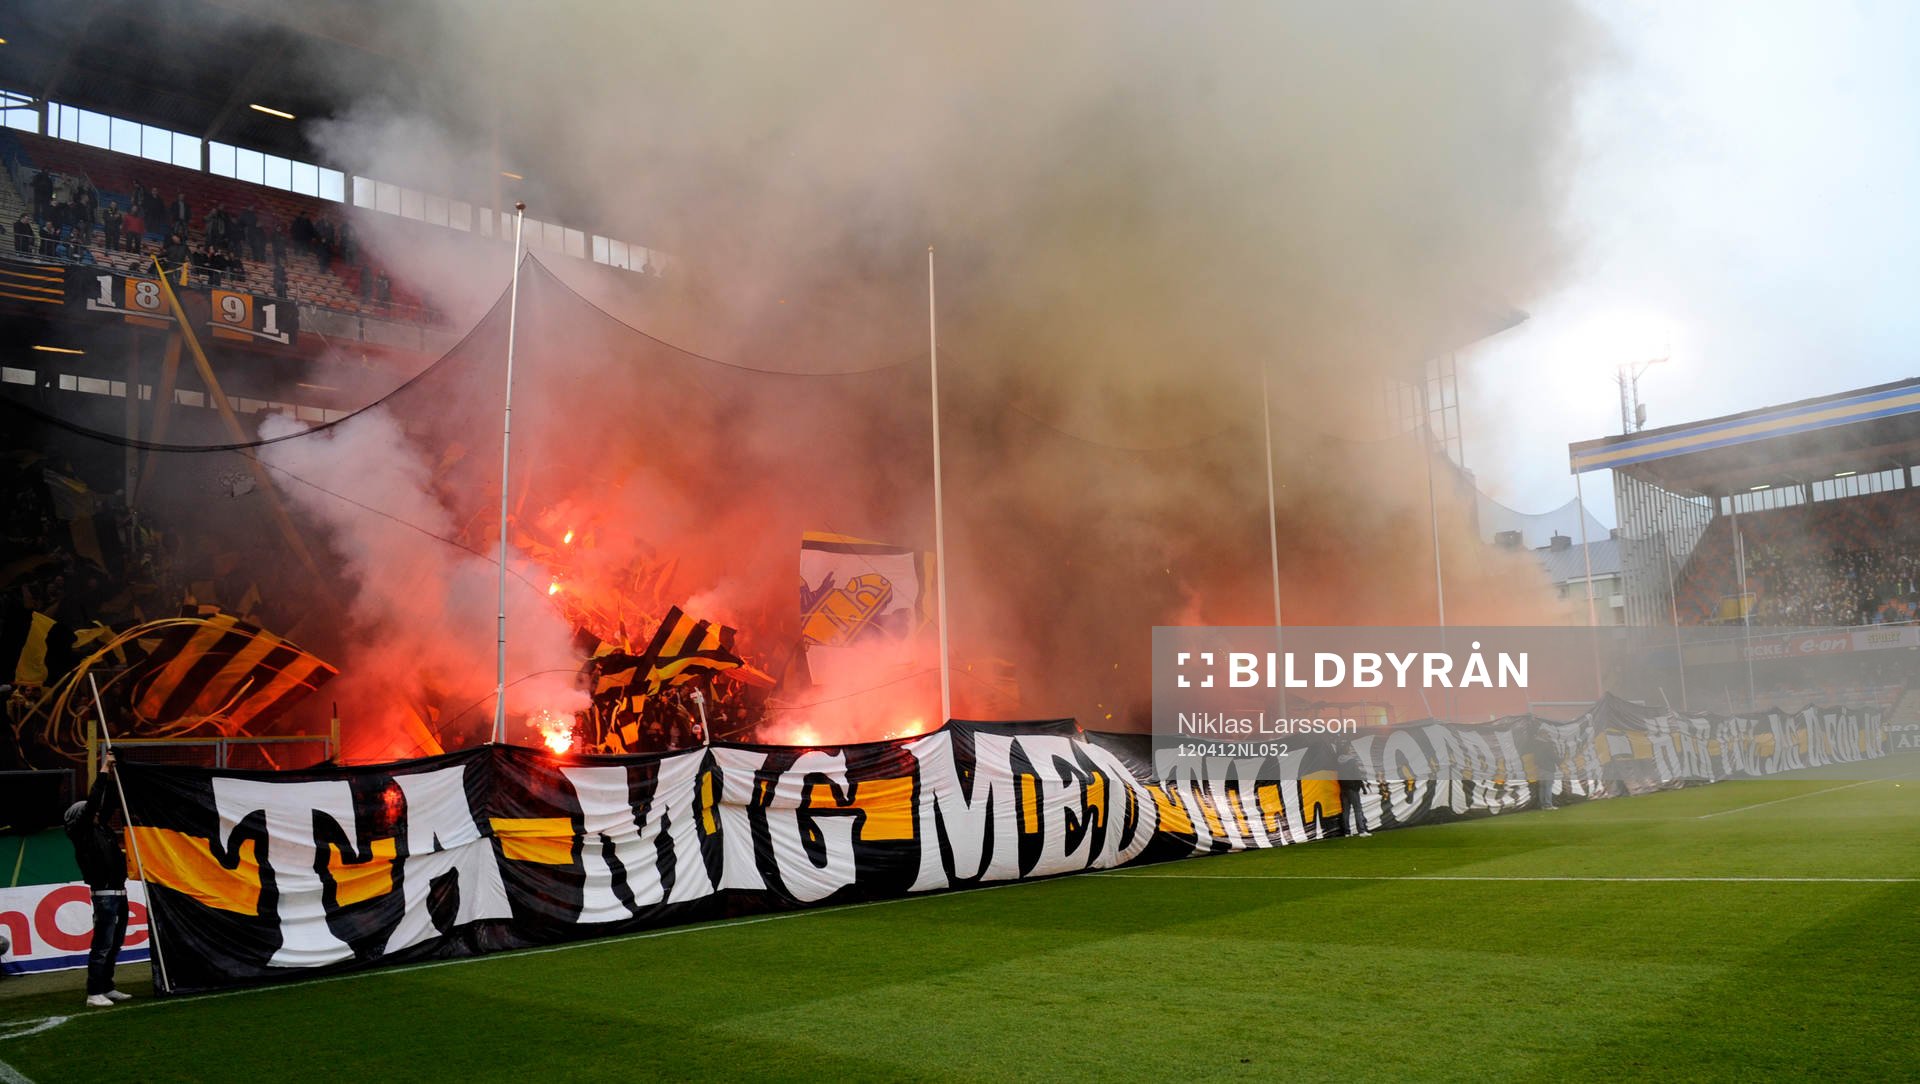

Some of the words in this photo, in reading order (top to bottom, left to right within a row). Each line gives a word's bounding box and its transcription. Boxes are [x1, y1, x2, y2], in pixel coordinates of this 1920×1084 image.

[212, 765, 512, 968] TA
[558, 746, 857, 923] MIG
[901, 730, 1159, 892] MED
